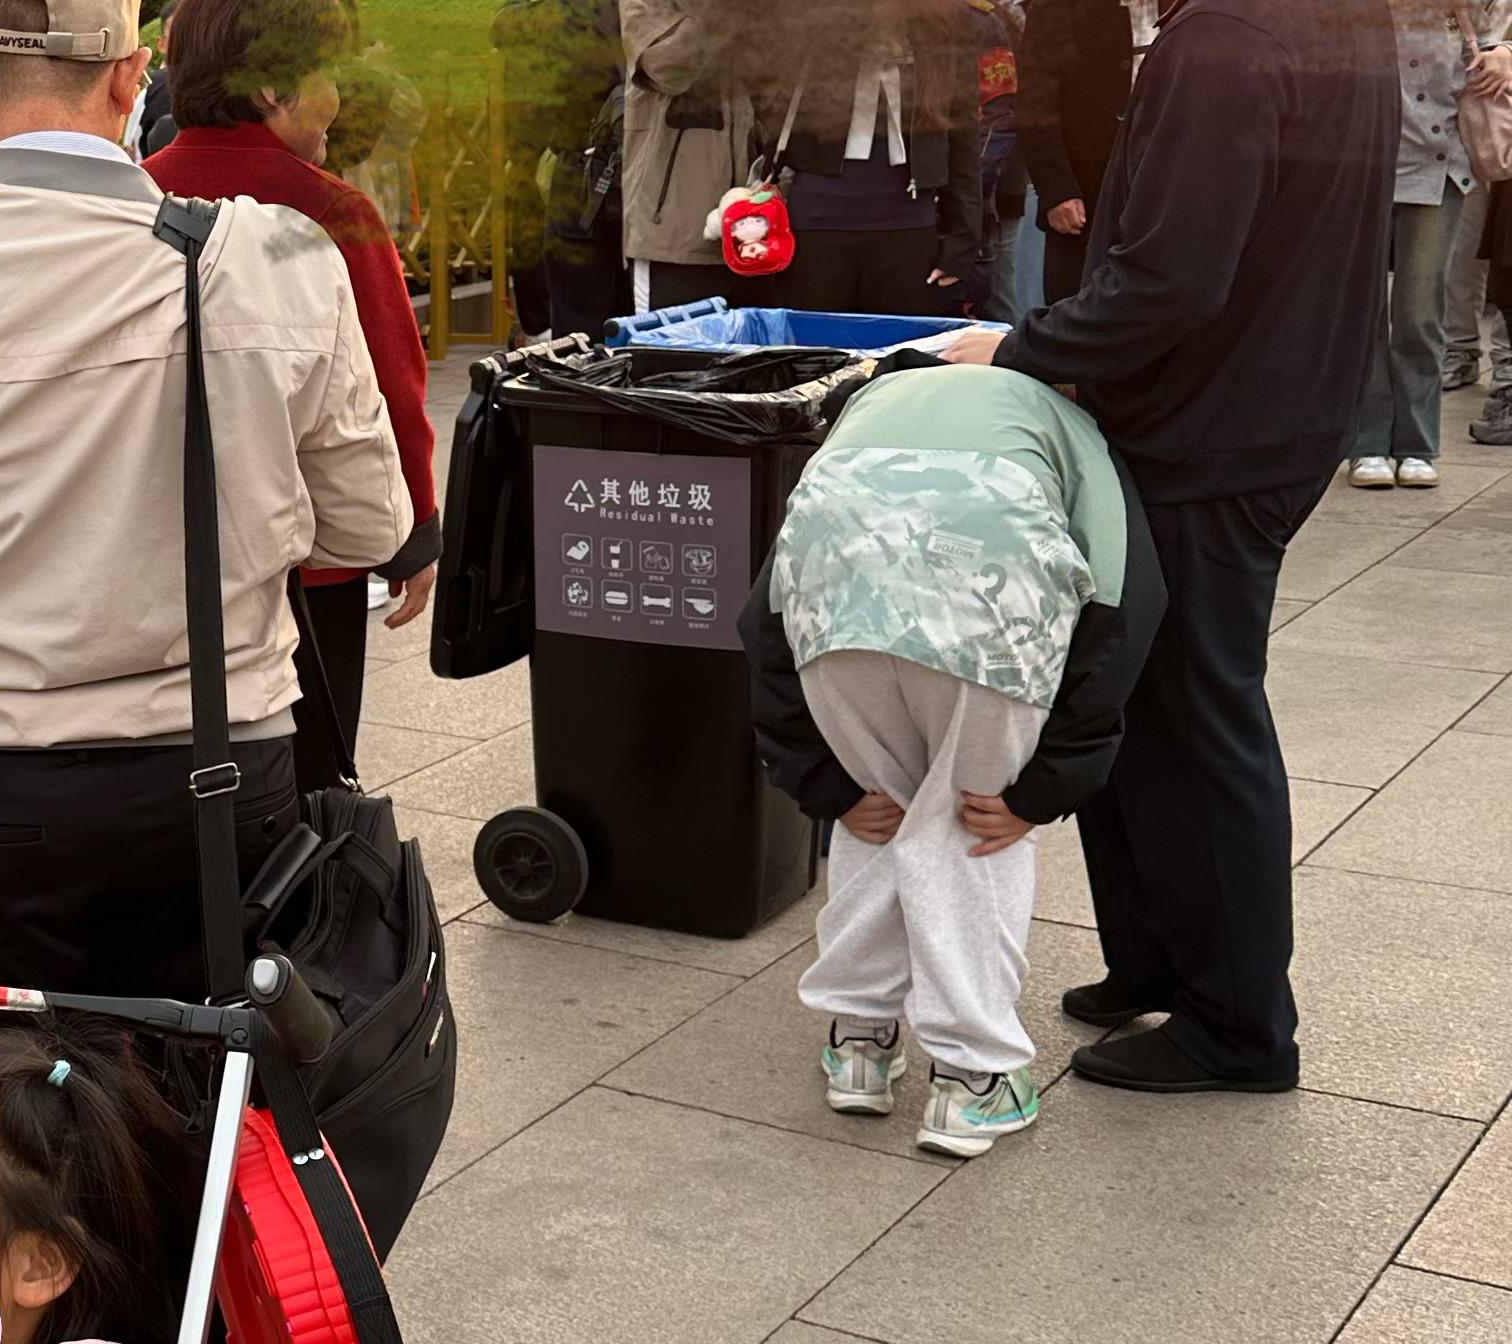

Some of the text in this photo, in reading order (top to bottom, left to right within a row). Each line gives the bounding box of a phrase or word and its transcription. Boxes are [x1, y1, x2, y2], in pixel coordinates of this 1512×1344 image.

[599, 478, 713, 511] 其他垃圾
[599, 507, 714, 527] Residual Waste
